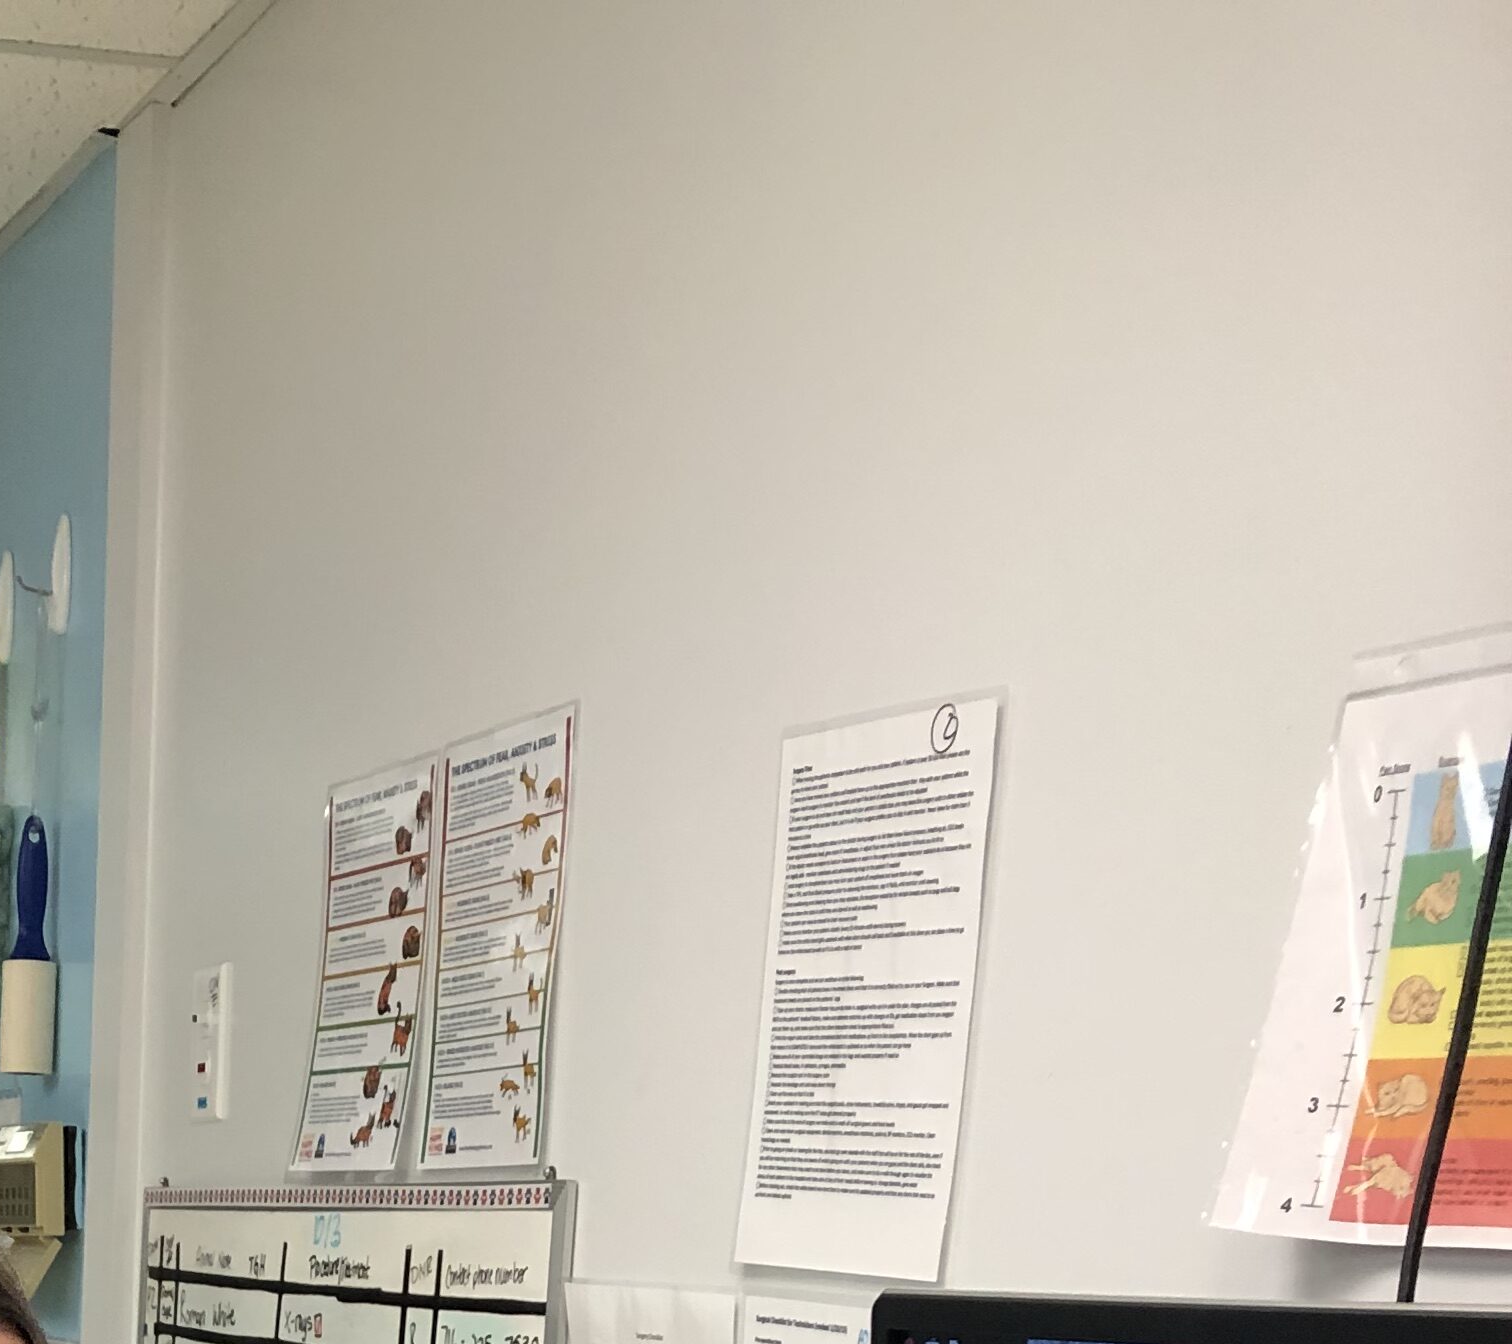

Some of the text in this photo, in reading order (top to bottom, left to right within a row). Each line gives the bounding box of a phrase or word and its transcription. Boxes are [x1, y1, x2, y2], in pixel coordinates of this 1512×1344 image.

[1373, 785, 1382, 804] 0
[1359, 893, 1366, 909] 1
[1332, 997, 1345, 1014] 2
[1307, 1098, 1319, 1114] 3
[1280, 1198, 1292, 1213] 4
[494, 1261, 529, 1286] number
